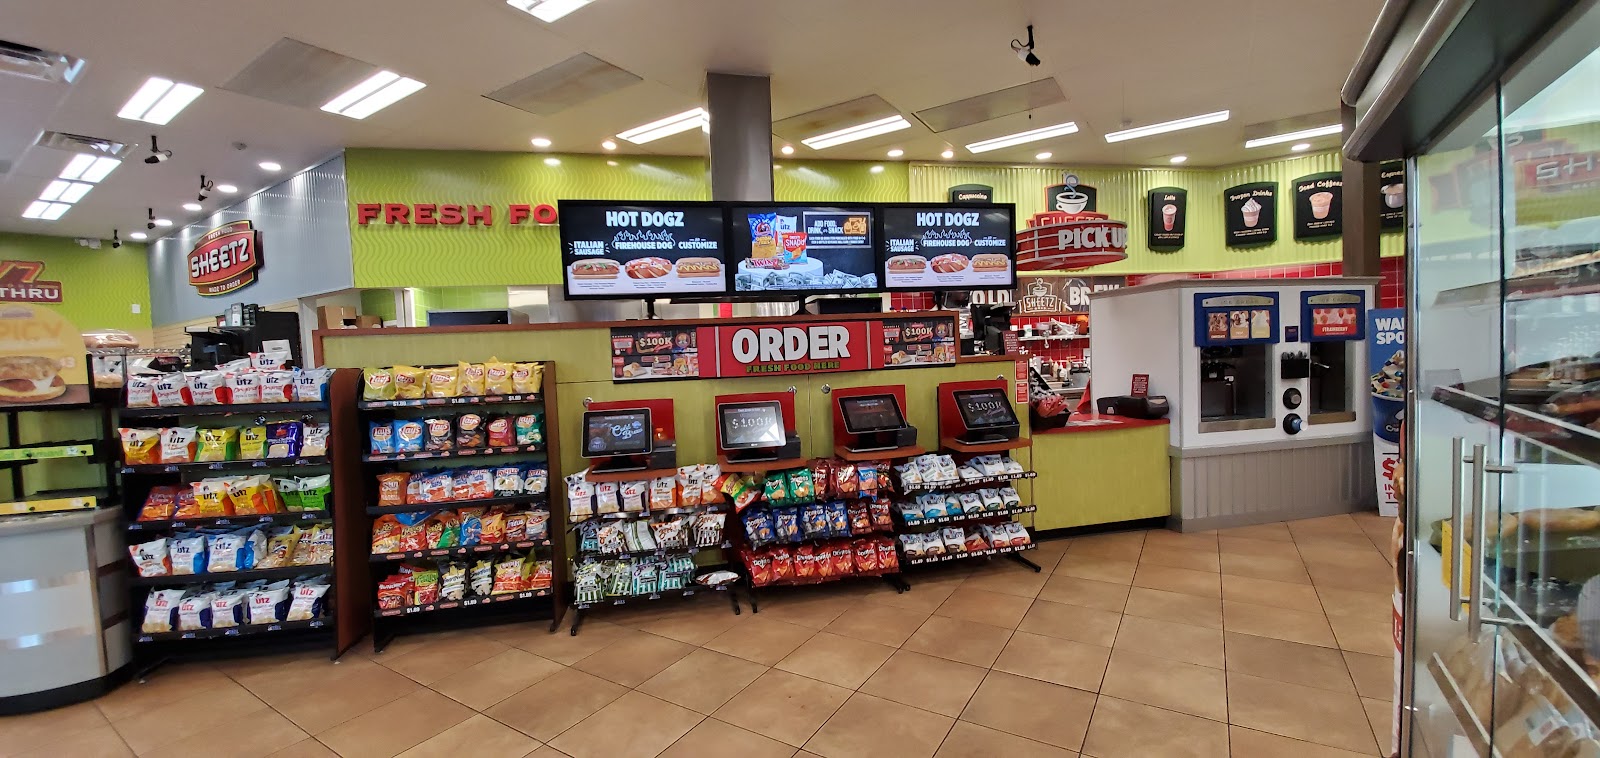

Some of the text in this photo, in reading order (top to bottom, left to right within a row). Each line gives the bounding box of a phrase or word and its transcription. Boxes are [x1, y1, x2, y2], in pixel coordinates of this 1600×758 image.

[958, 193, 988, 201] Cappuccino
[356, 203, 493, 226] FRESH
[606, 211, 684, 227] HOT DOGZ
[916, 212, 980, 226] HOT DOGZ
[1058, 227, 1110, 251] PICK
[191, 238, 249, 278] SHEETZ
[0, 288, 58, 298] THRU
[969, 290, 1010, 306] OLD
[1026, 298, 1054, 308] SHEETZ
[906, 327, 933, 336] $100K
[640, 337, 672, 347] $100K
[732, 325, 850, 364] ORDER
[746, 362, 840, 373] FRESH FOOD HERE
[611, 424, 631, 436] Cold
[622, 428, 643, 440] Brew
